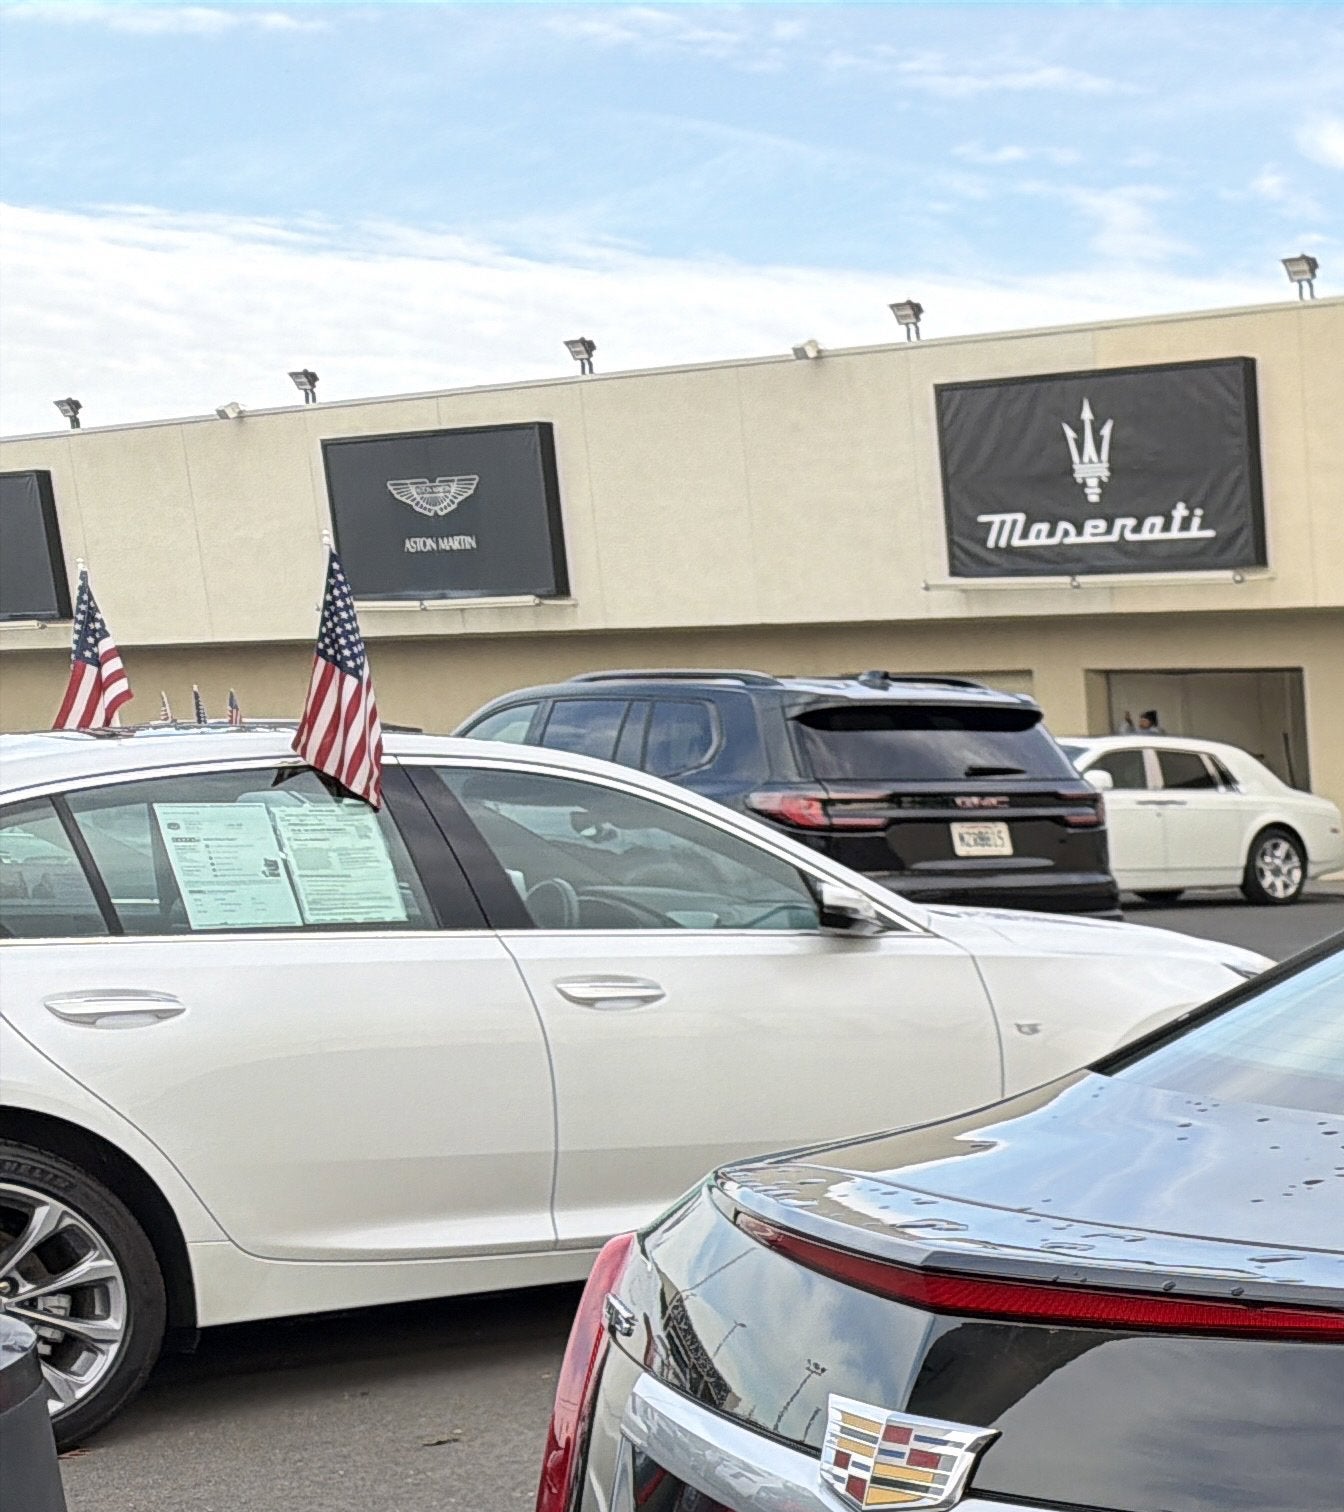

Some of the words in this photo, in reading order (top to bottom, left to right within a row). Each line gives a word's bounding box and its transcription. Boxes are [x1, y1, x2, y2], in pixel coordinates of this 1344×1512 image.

[977, 501, 1216, 548] Maserati
[404, 536, 438, 553] ASTON
[438, 535, 477, 551] MARTIN
